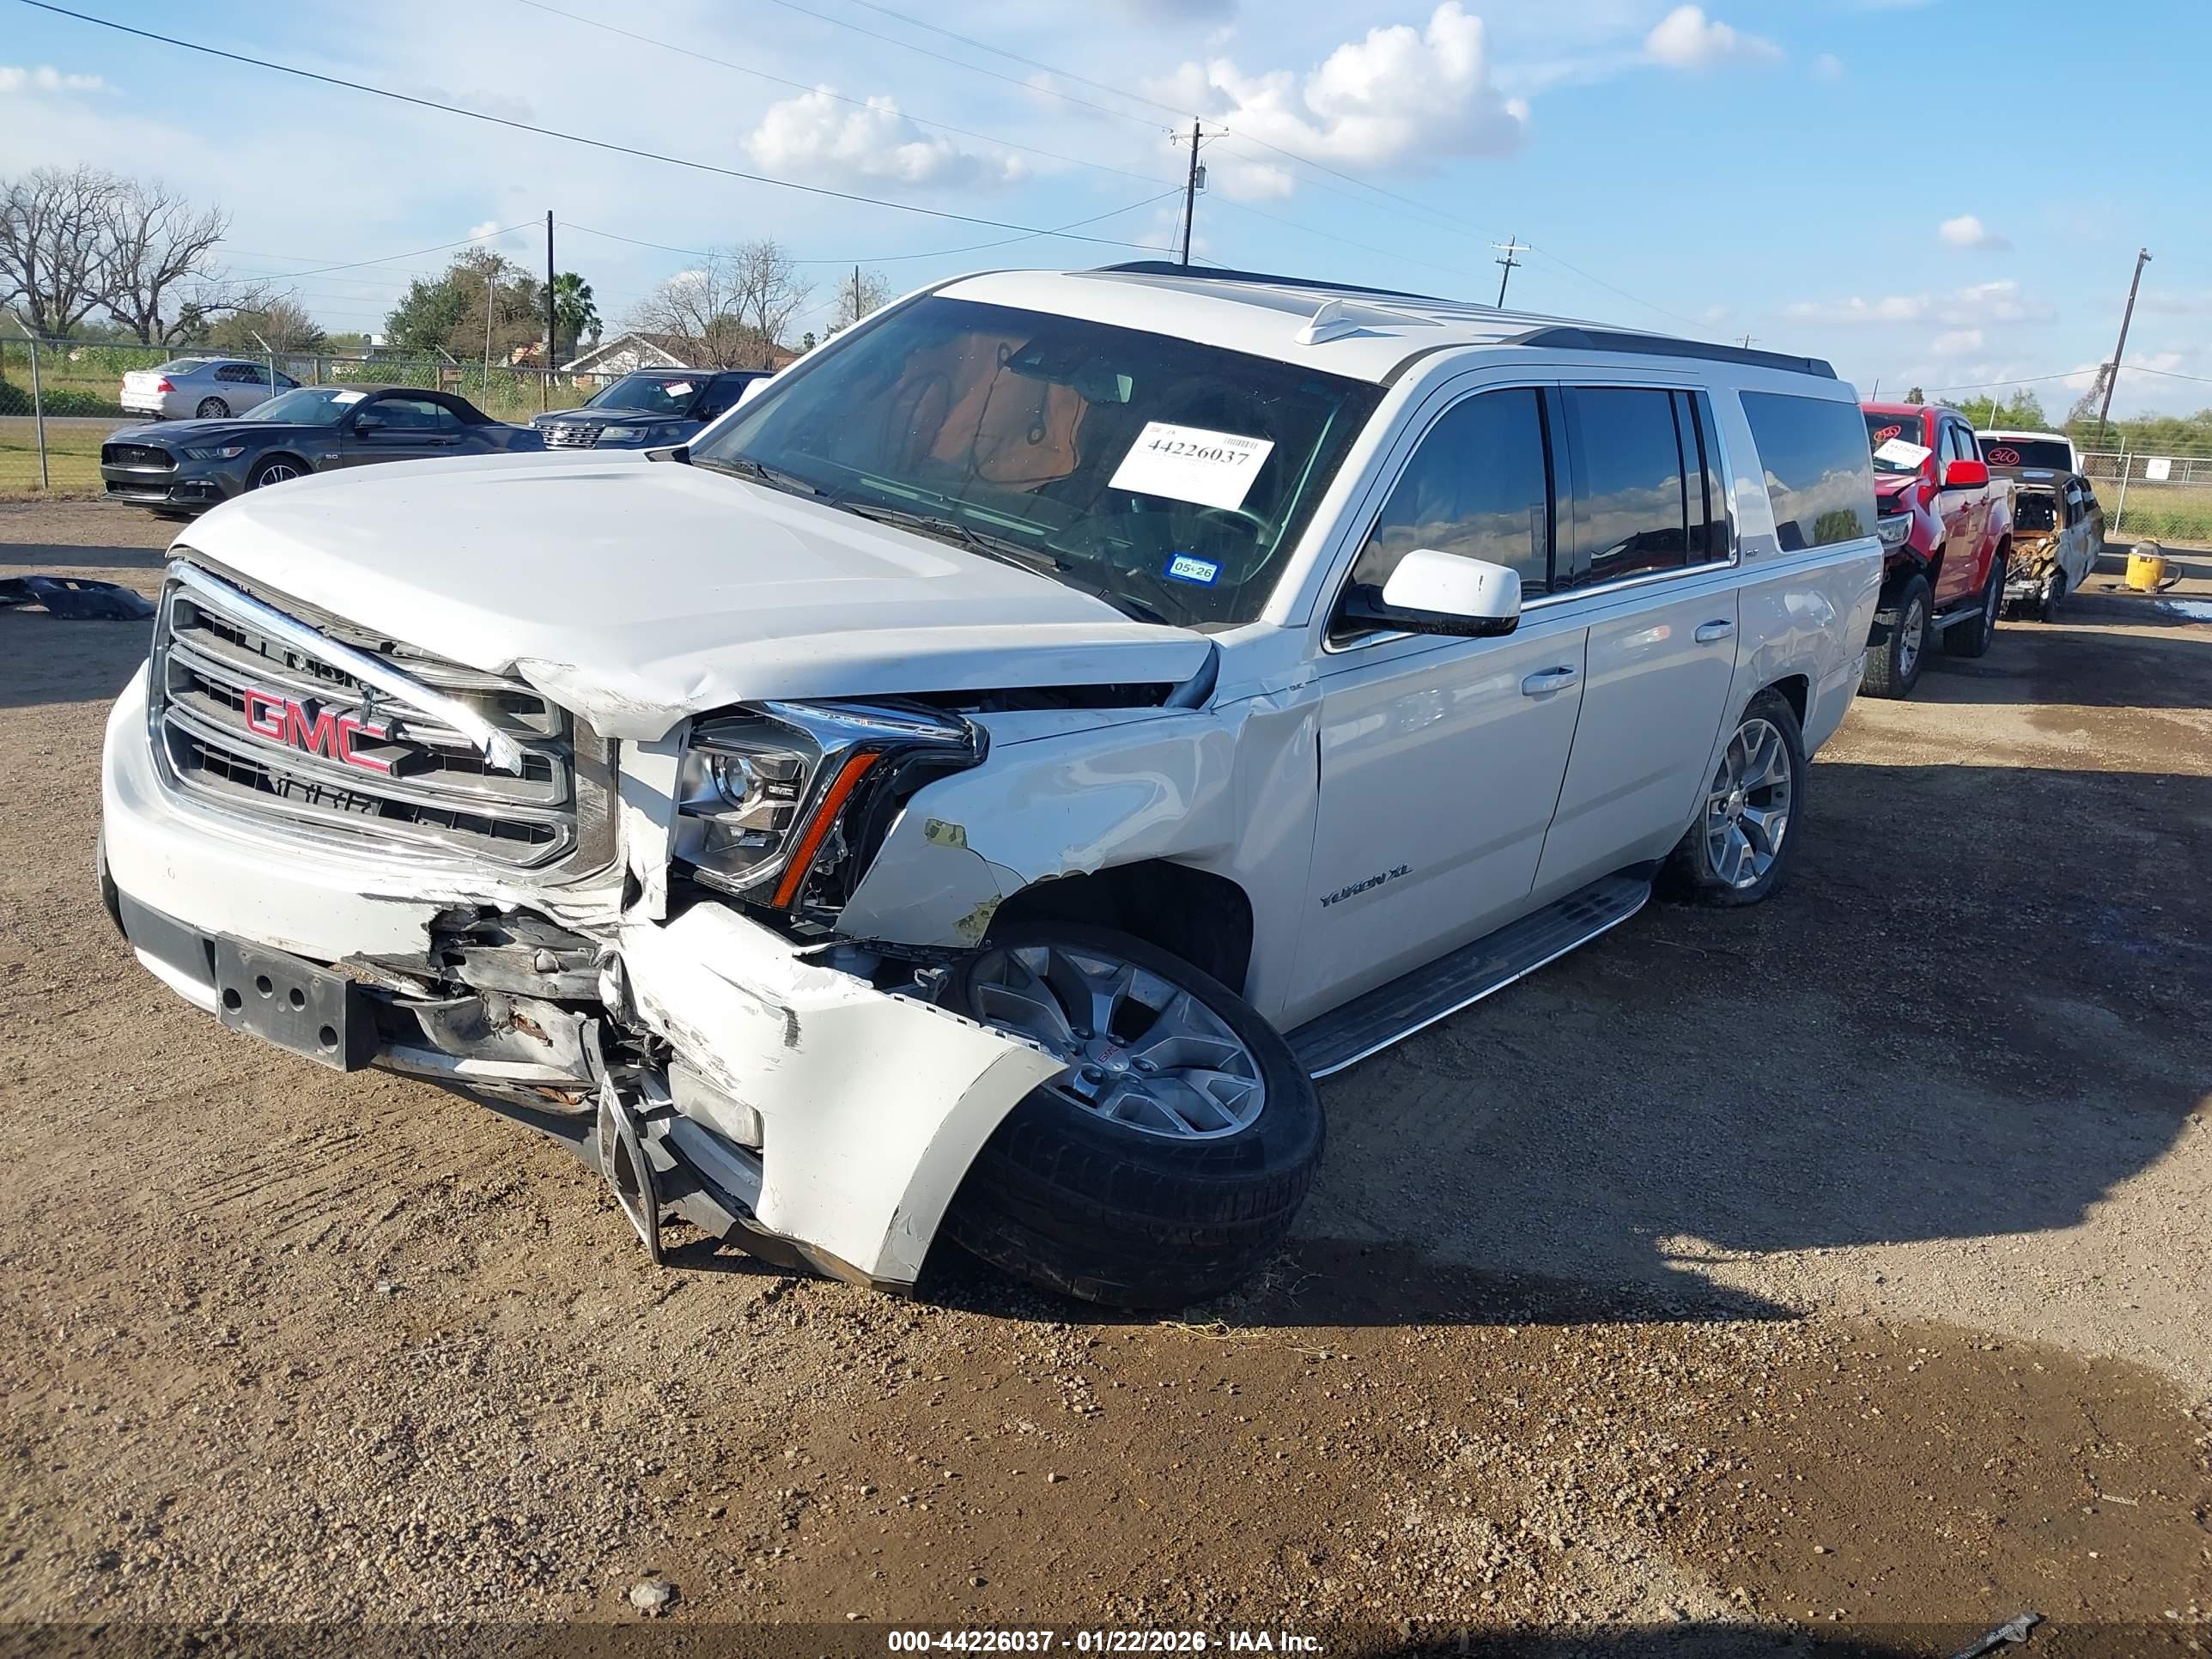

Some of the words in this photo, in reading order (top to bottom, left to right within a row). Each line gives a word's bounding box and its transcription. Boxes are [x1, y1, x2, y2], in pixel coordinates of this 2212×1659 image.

[1147, 439, 1250, 465] 44226037
[244, 688, 395, 775] GMC
[1320, 872, 1387, 908] YUKON
[1387, 863, 1414, 881] XL
